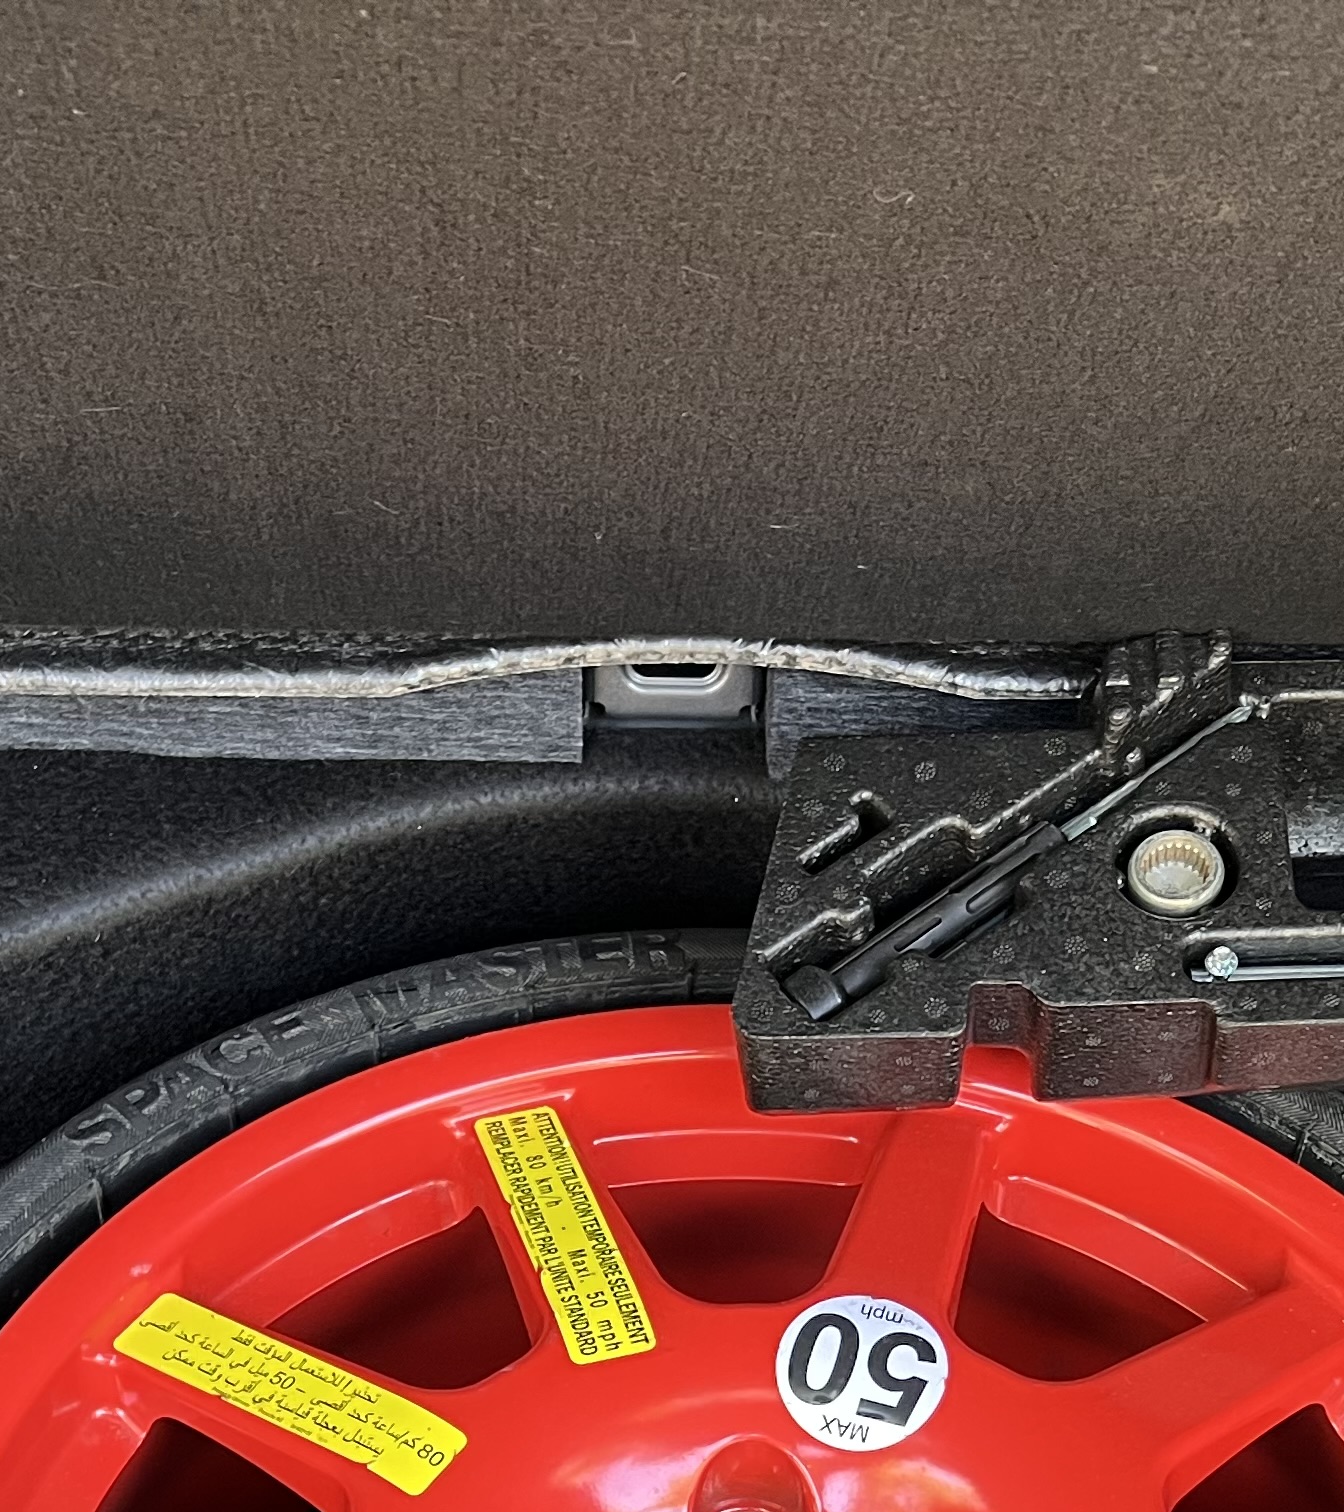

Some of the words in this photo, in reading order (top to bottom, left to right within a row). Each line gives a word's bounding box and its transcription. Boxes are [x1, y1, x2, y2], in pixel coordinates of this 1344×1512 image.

[65, 1012, 322, 1158] SPACE
[359, 931, 686, 1029] MASTER
[524, 1153, 547, 1170] 80
[531, 1175, 564, 1209] km/h
[483, 1119, 524, 1176] REMPLACER
[508, 1174, 550, 1236] RAPIDEMENT
[533, 1235, 558, 1257] PAR
[557, 1293, 600, 1357] STANDARD
[565, 1247, 598, 1284] Maxi.
[578, 1216, 622, 1280] TEMPORAIRE
[603, 1276, 651, 1347] SEULEMENT
[584, 1289, 608, 1309] 50
[860, 1304, 903, 1324] mph
[591, 1318, 623, 1353] mph
[266, 1369, 298, 1391] 50
[788, 1313, 937, 1428] 50
[818, 1414, 870, 1443] MAX
[411, 1442, 449, 1468] 80
